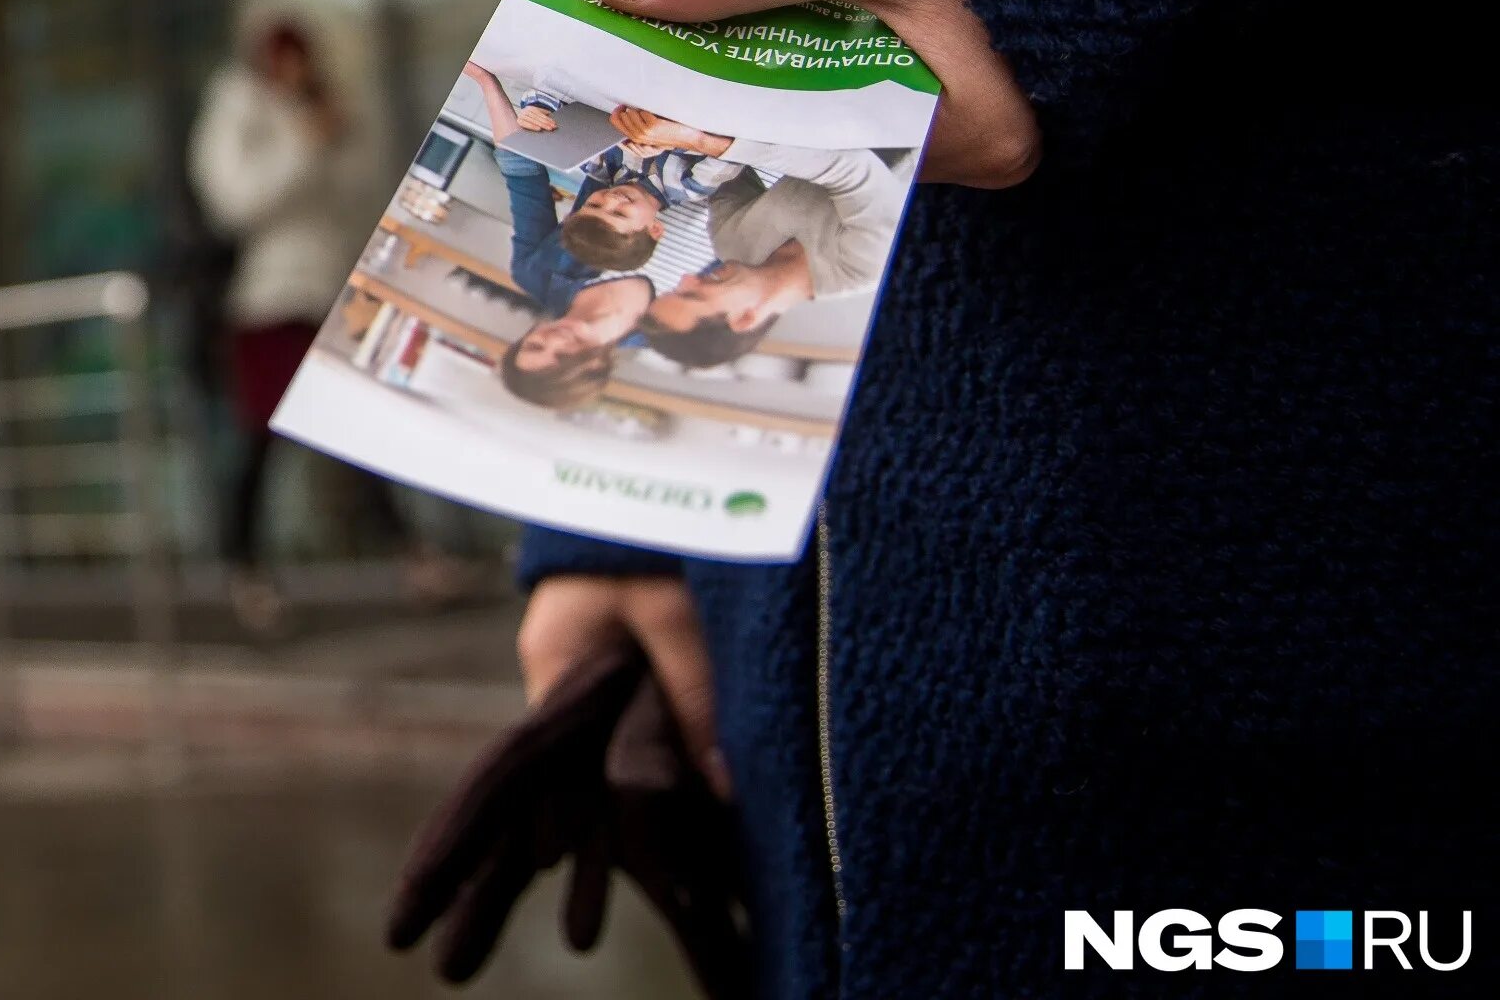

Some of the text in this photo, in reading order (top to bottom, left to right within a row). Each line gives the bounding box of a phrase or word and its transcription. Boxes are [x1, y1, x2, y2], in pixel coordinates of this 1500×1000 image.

[724, 25, 912, 52] ЕЗНАЛИЧНЫМ
[724, 45, 914, 69] ОПЛАЧИВАЙТЕ
[553, 460, 713, 510] СБЕРБАНК
